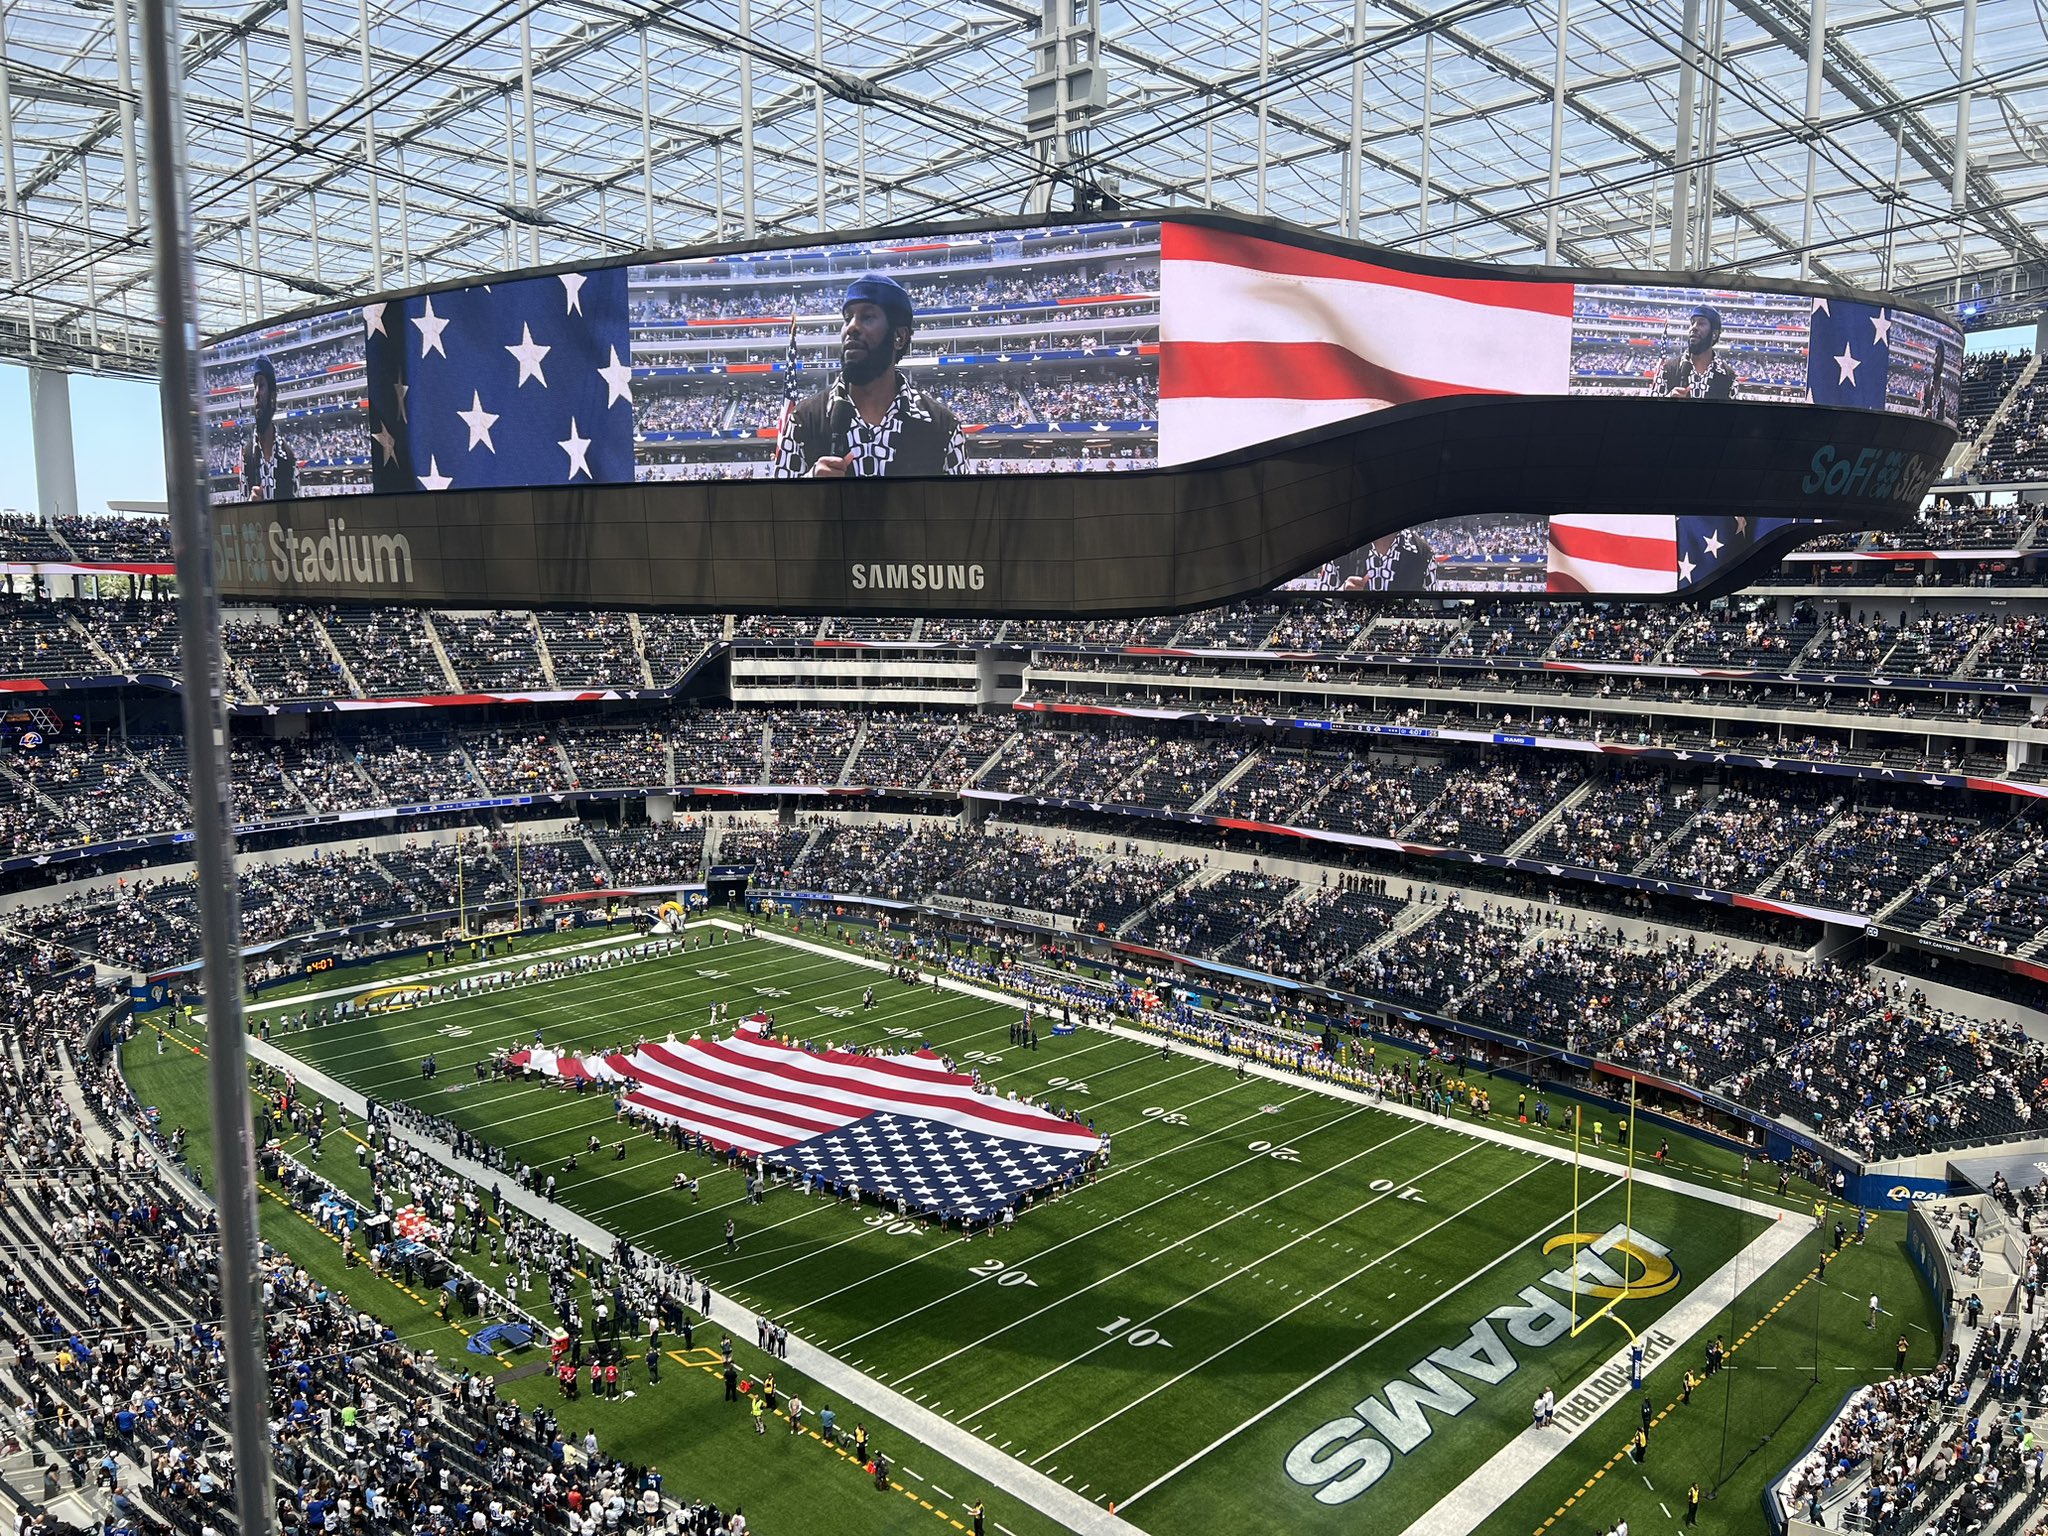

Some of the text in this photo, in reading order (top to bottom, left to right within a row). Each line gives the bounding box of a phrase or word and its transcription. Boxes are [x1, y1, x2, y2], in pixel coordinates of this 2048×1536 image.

[1801, 445, 1881, 497] SoFi
[268, 517, 414, 583] Stadium
[851, 563, 985, 591] SAMSUNG
[1868, 927, 1878, 936] CC
[311, 958, 333, 970] 4:07
[963, 1050, 1003, 1065] 50
[1141, 1106, 1187, 1125] 30
[1248, 1140, 1300, 1160] 20
[1369, 1179, 1423, 1200] 10
[863, 1211, 916, 1235] 30
[968, 1259, 1028, 1287] 20
[1096, 1315, 1160, 1348] 10
[1284, 1284, 1583, 1506] RAMS
